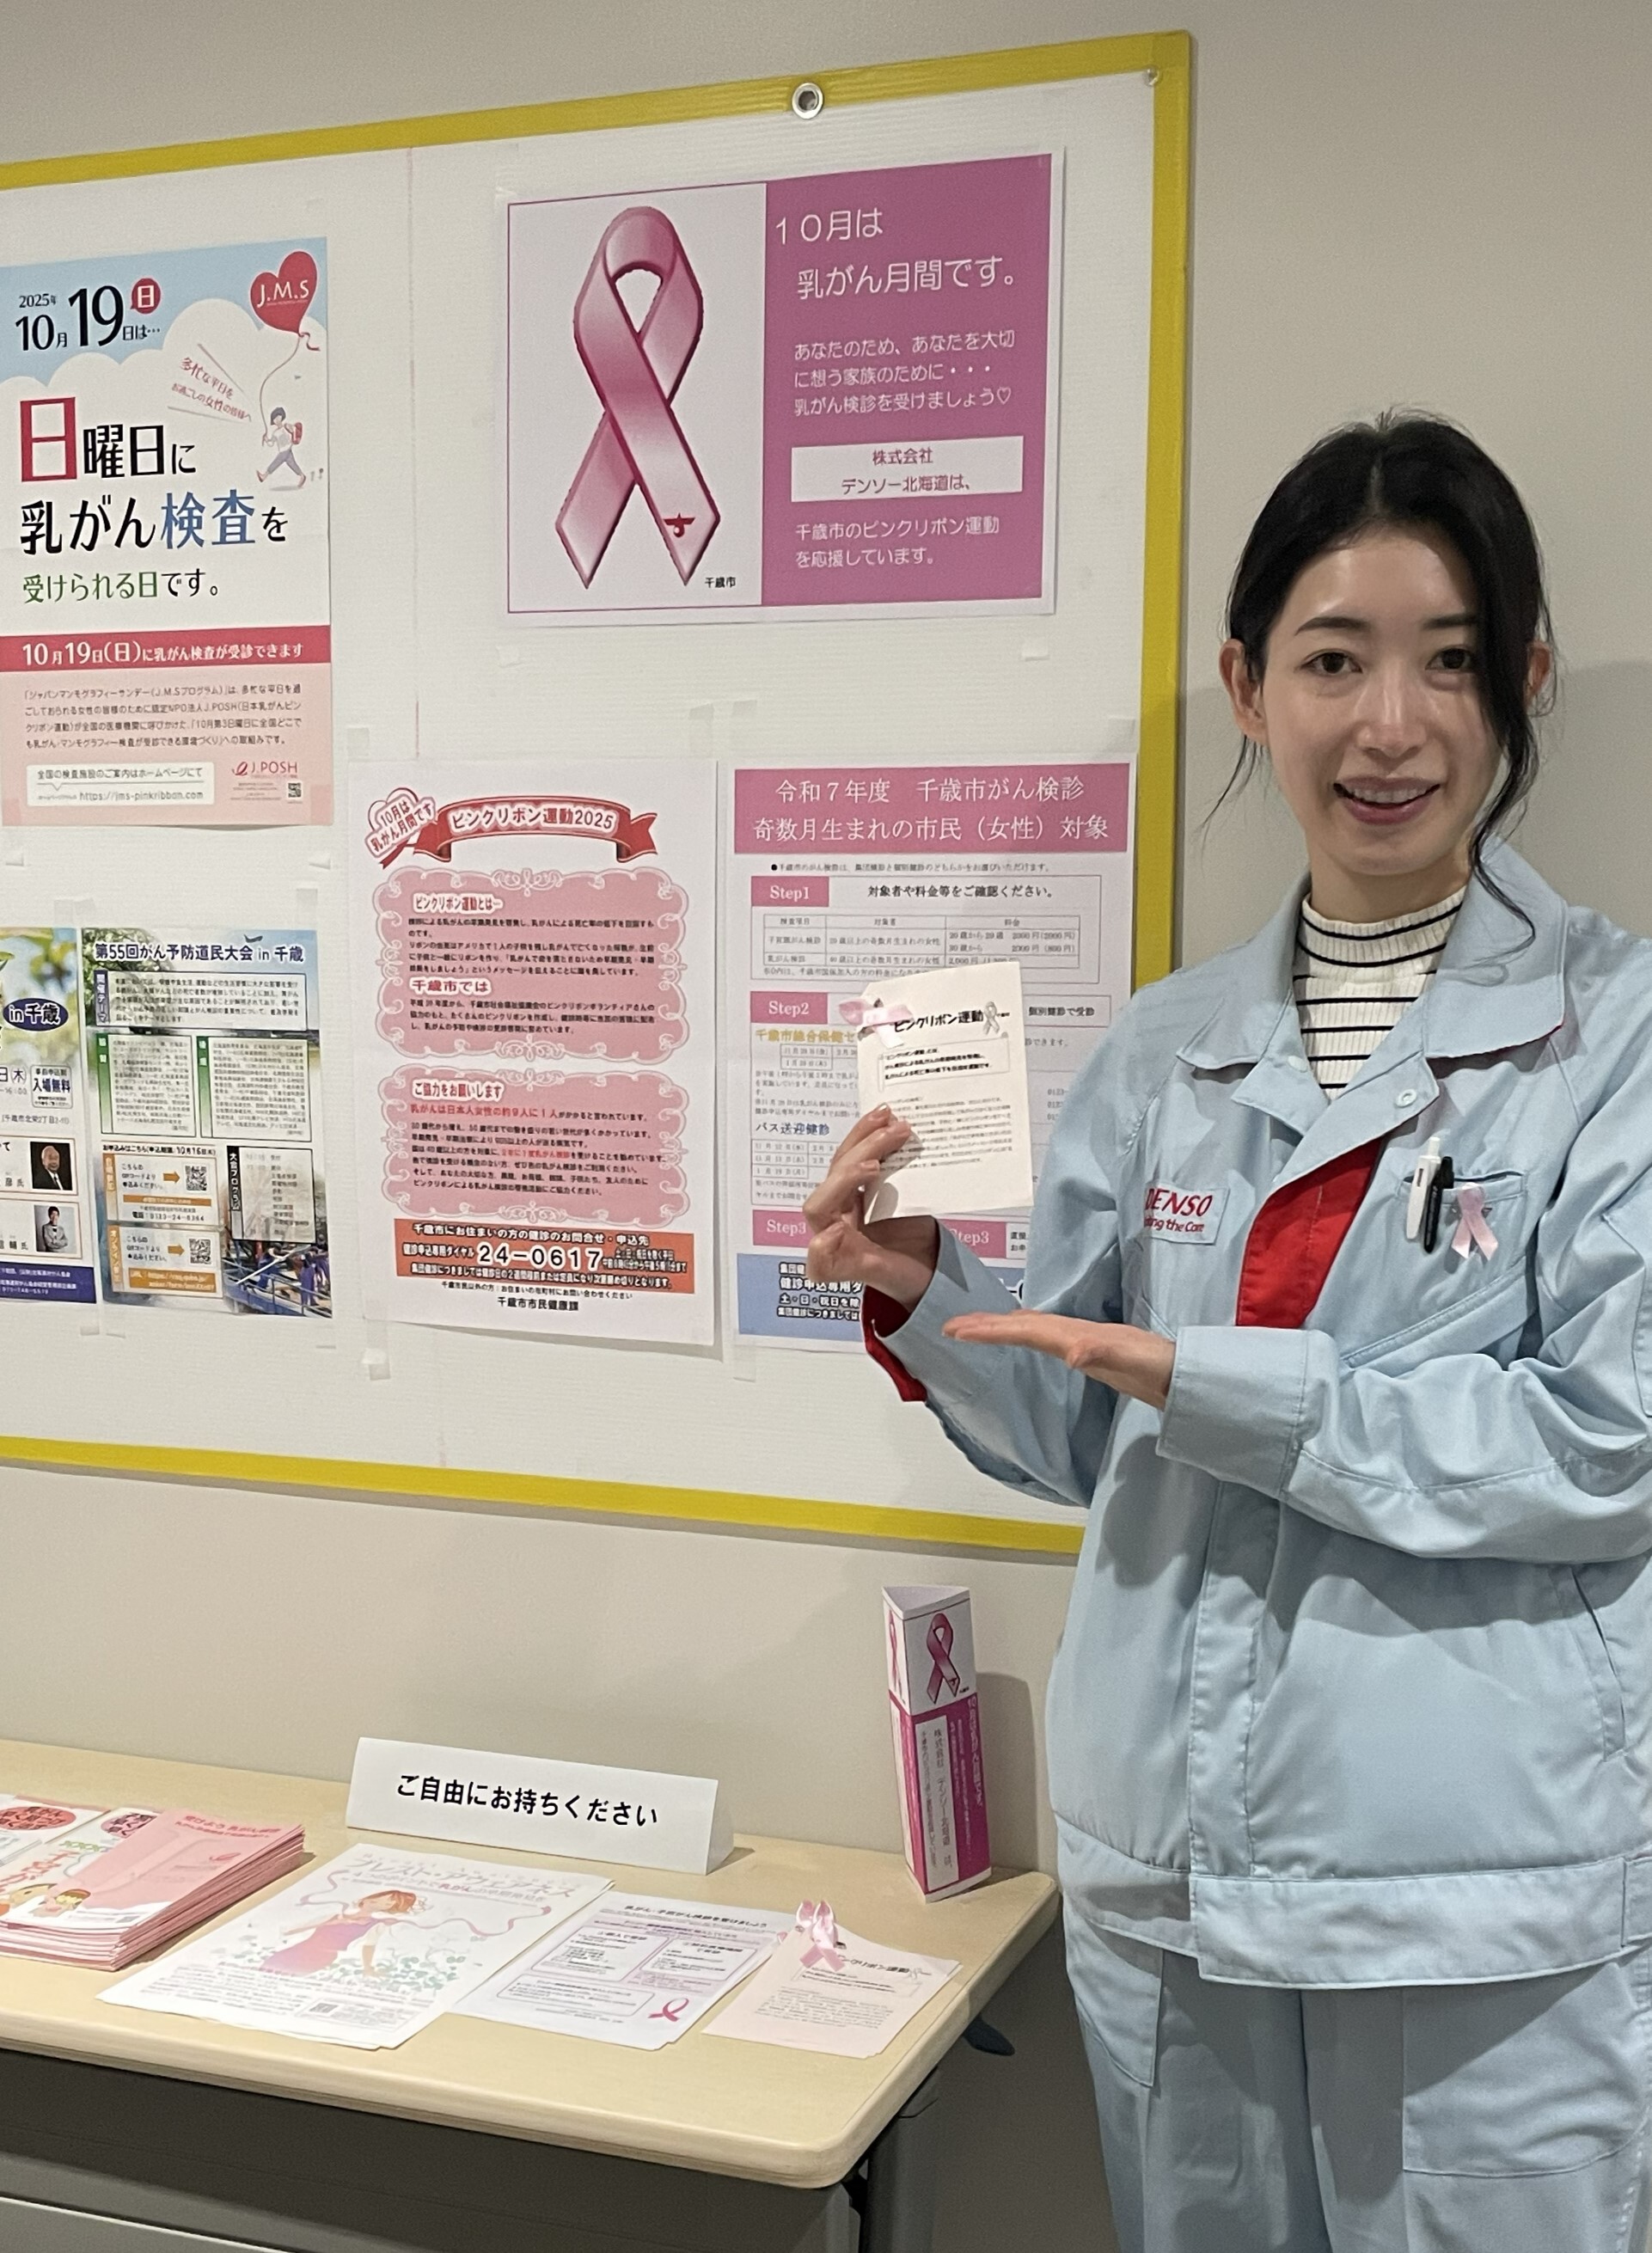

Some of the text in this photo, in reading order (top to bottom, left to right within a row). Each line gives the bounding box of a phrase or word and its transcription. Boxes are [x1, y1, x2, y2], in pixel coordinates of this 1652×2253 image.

[775, 207, 884, 245] １０月は
[796, 255, 1015, 300] 乳がん月間です。
[19, 294, 57, 309] 2025年
[137, 286, 154, 308] 日
[257, 279, 309, 308] J.M.S
[793, 329, 1015, 362] あなたのため、あなたを大切
[20, 396, 197, 483] 日曜日に
[872, 447, 934, 466] 株式会社
[841, 474, 971, 495] デンソー北海道は、
[20, 487, 290, 555] 乳がん検査を
[795, 515, 1000, 541] 千歳市のピンクリボン運動
[795, 546, 935, 569] を応援しています。
[22, 567, 219, 603] 受けられる日です。
[704, 576, 737, 588] 千歳市
[775, 775, 1085, 804] 令和７年度 千歳市がん検診
[379, 799, 411, 825] 10月は
[450, 805, 615, 831] ピンクリボン運動2025
[370, 803, 434, 852] 乳がん月間です
[752, 813, 1109, 842] 奇数月生まれの市民（女性）対象
[769, 885, 810, 902] Step1
[867, 885, 1053, 898] 対象者や料金等をご確認ください。
[95, 943, 253, 961] 第55回がん予防道民大会
[274, 946, 304, 962] 千歳
[412, 979, 489, 993] 千歳市では
[9, 1002, 60, 1025] in千歳
[768, 1001, 810, 1017] Step2
[894, 1010, 984, 1032] ピンクリボン運動
[414, 1082, 503, 1099] ご協力をお願いします
[756, 1122, 829, 1136] バス送迎健診
[766, 1220, 807, 1237] Step3
[478, 1244, 602, 1270] 24-0617
[397, 1774, 658, 1828] ご自由にお持ちください
